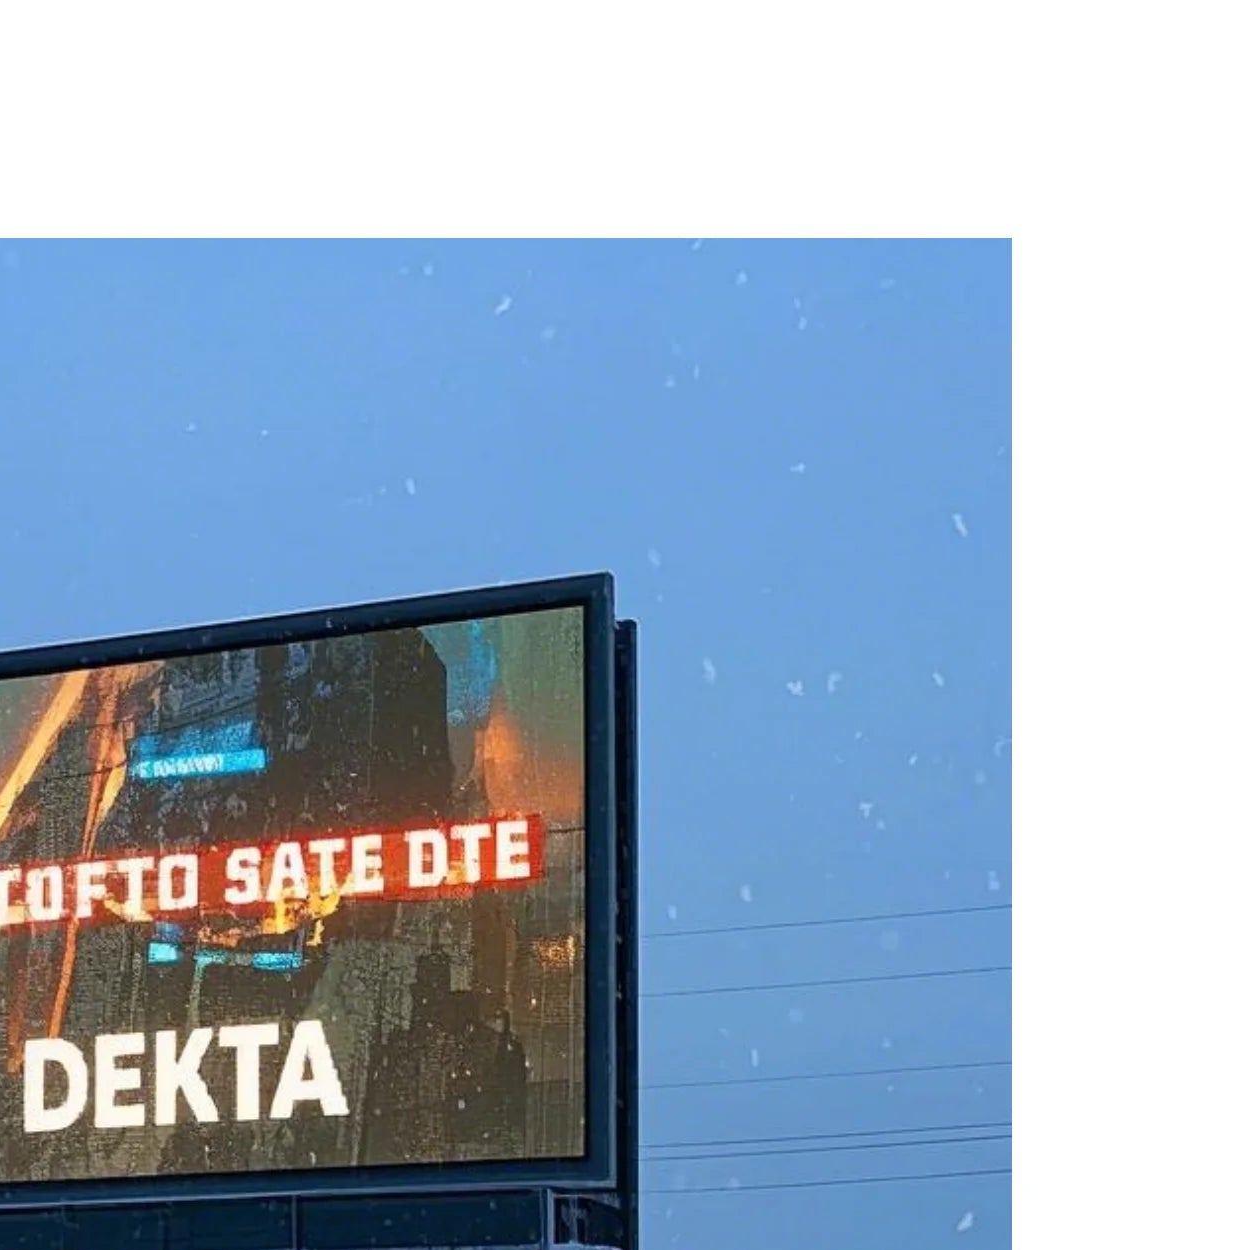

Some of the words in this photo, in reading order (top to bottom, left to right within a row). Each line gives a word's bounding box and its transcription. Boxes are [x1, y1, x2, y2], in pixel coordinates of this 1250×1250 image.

[224, 834, 385, 905] SATE
[405, 820, 531, 888] DTE
[22, 1019, 350, 1133] DEKTA
